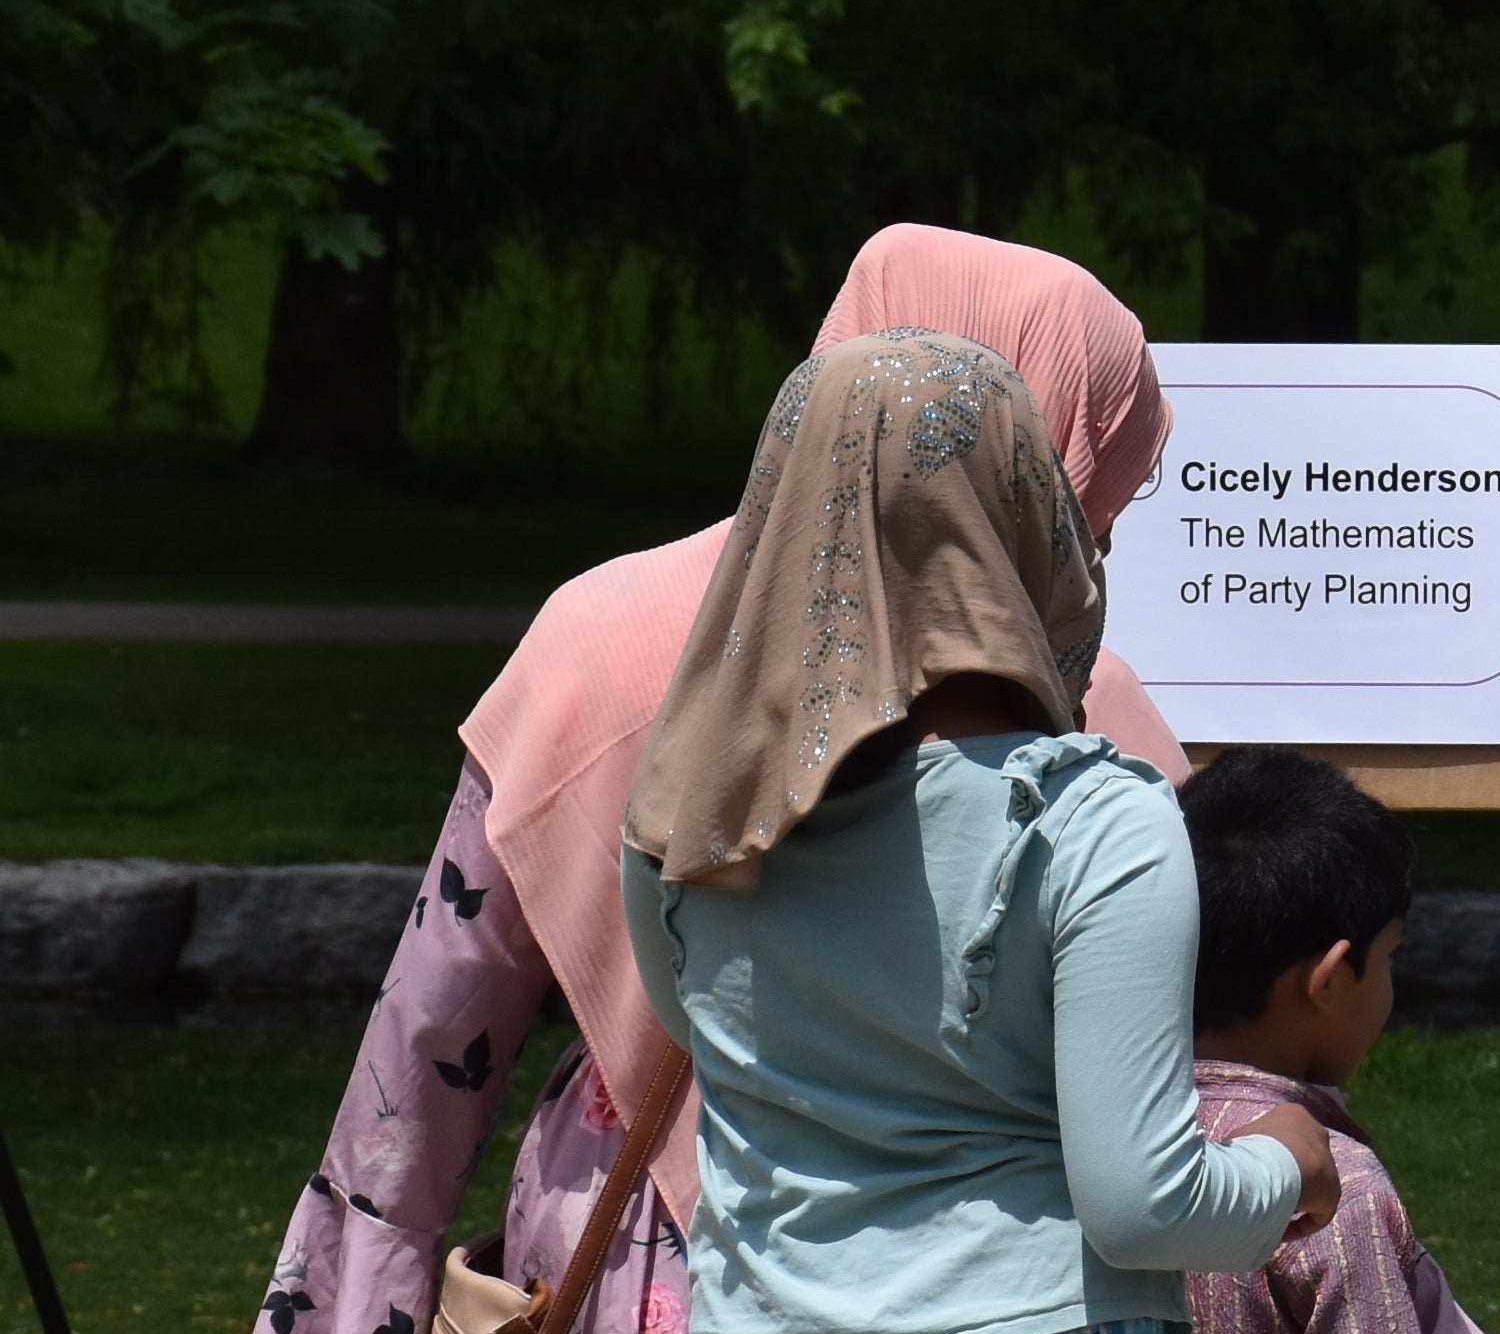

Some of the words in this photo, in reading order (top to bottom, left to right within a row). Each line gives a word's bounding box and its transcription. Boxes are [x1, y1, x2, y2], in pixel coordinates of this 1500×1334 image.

[1180, 461, 1292, 499] Cicely
[1180, 518, 1244, 548] The
[1259, 518, 1474, 549] Mathematics
[1180, 574, 1212, 604] of
[1225, 575, 1310, 612] Party
[1324, 575, 1471, 612] Planning
